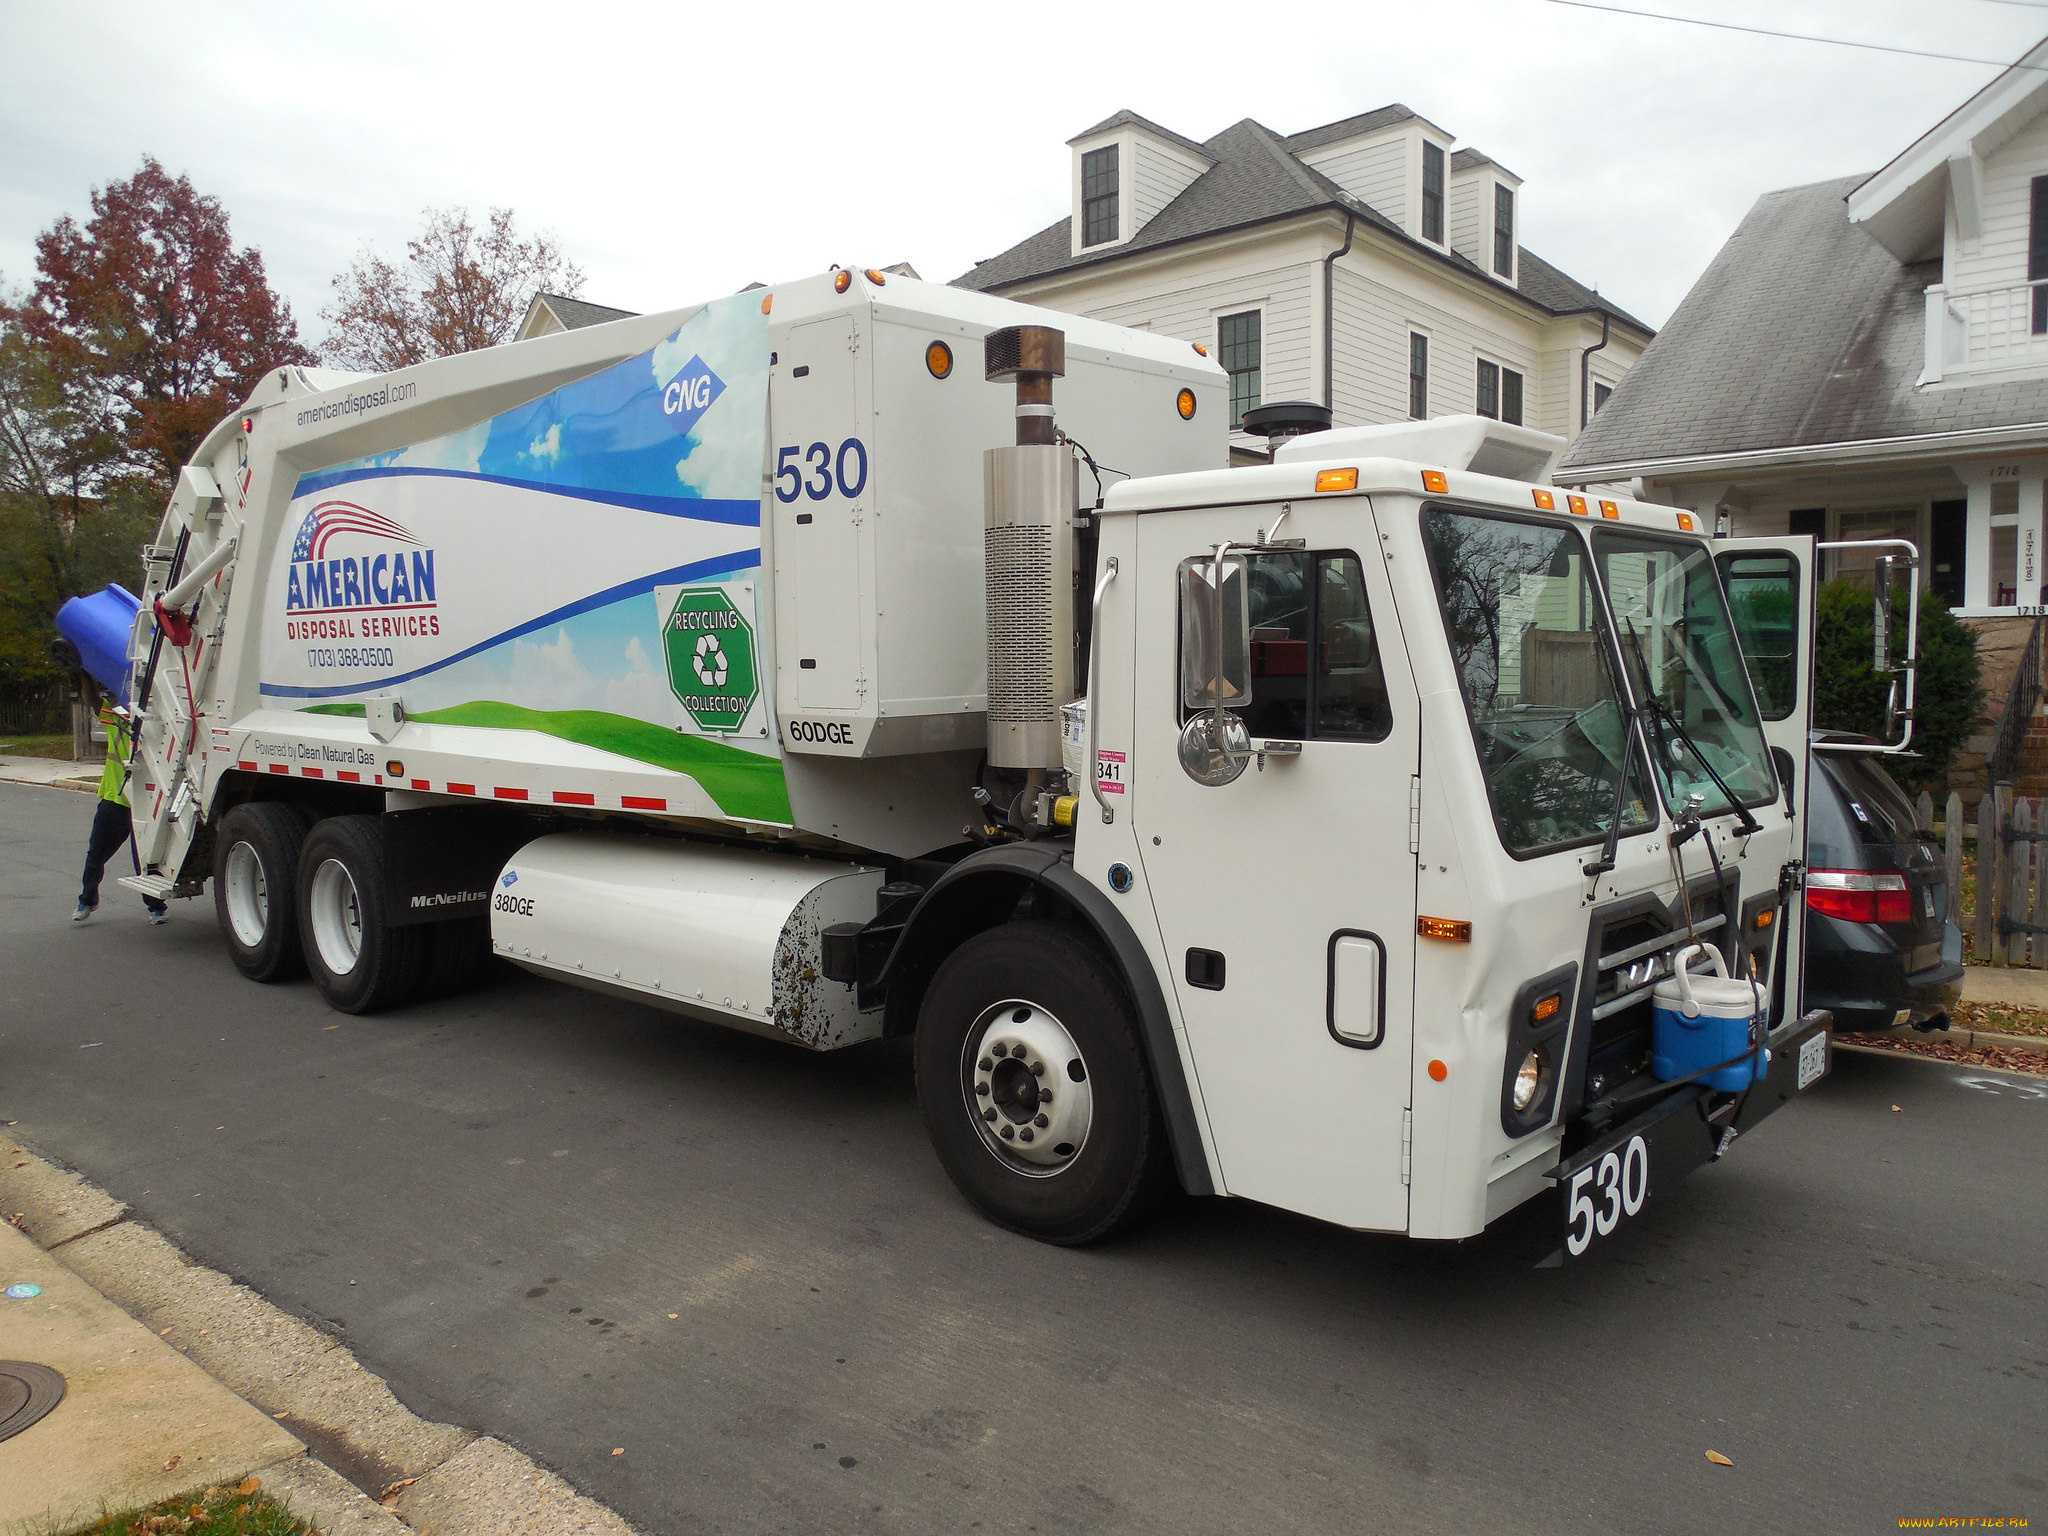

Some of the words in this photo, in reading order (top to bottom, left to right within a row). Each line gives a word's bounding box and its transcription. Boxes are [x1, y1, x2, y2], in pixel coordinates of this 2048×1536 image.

[297, 380, 417, 427] americandisposal.com
[662, 373, 711, 415] CNG
[775, 437, 868, 504] 530
[286, 549, 436, 610] AMERICAN
[674, 610, 738, 632] RECYCLING
[2017, 606, 2045, 616] 1718
[287, 616, 356, 640] DISPOSAL
[361, 614, 441, 638] SERVICES
[307, 647, 336, 669] (703)
[338, 647, 394, 667] 368-0500
[684, 695, 748, 714] COLLECTION
[789, 720, 854, 745] 60DGE
[254, 738, 287, 758] Powered
[288, 745, 297, 761] by
[298, 743, 320, 761] Clean
[322, 745, 355, 764] Natural
[357, 748, 375, 765] Gas
[1098, 762, 1119, 781] 341
[410, 889, 487, 909] McNeilus
[494, 893, 535, 917] 38DGE
[1565, 1136, 1649, 1257] 530
